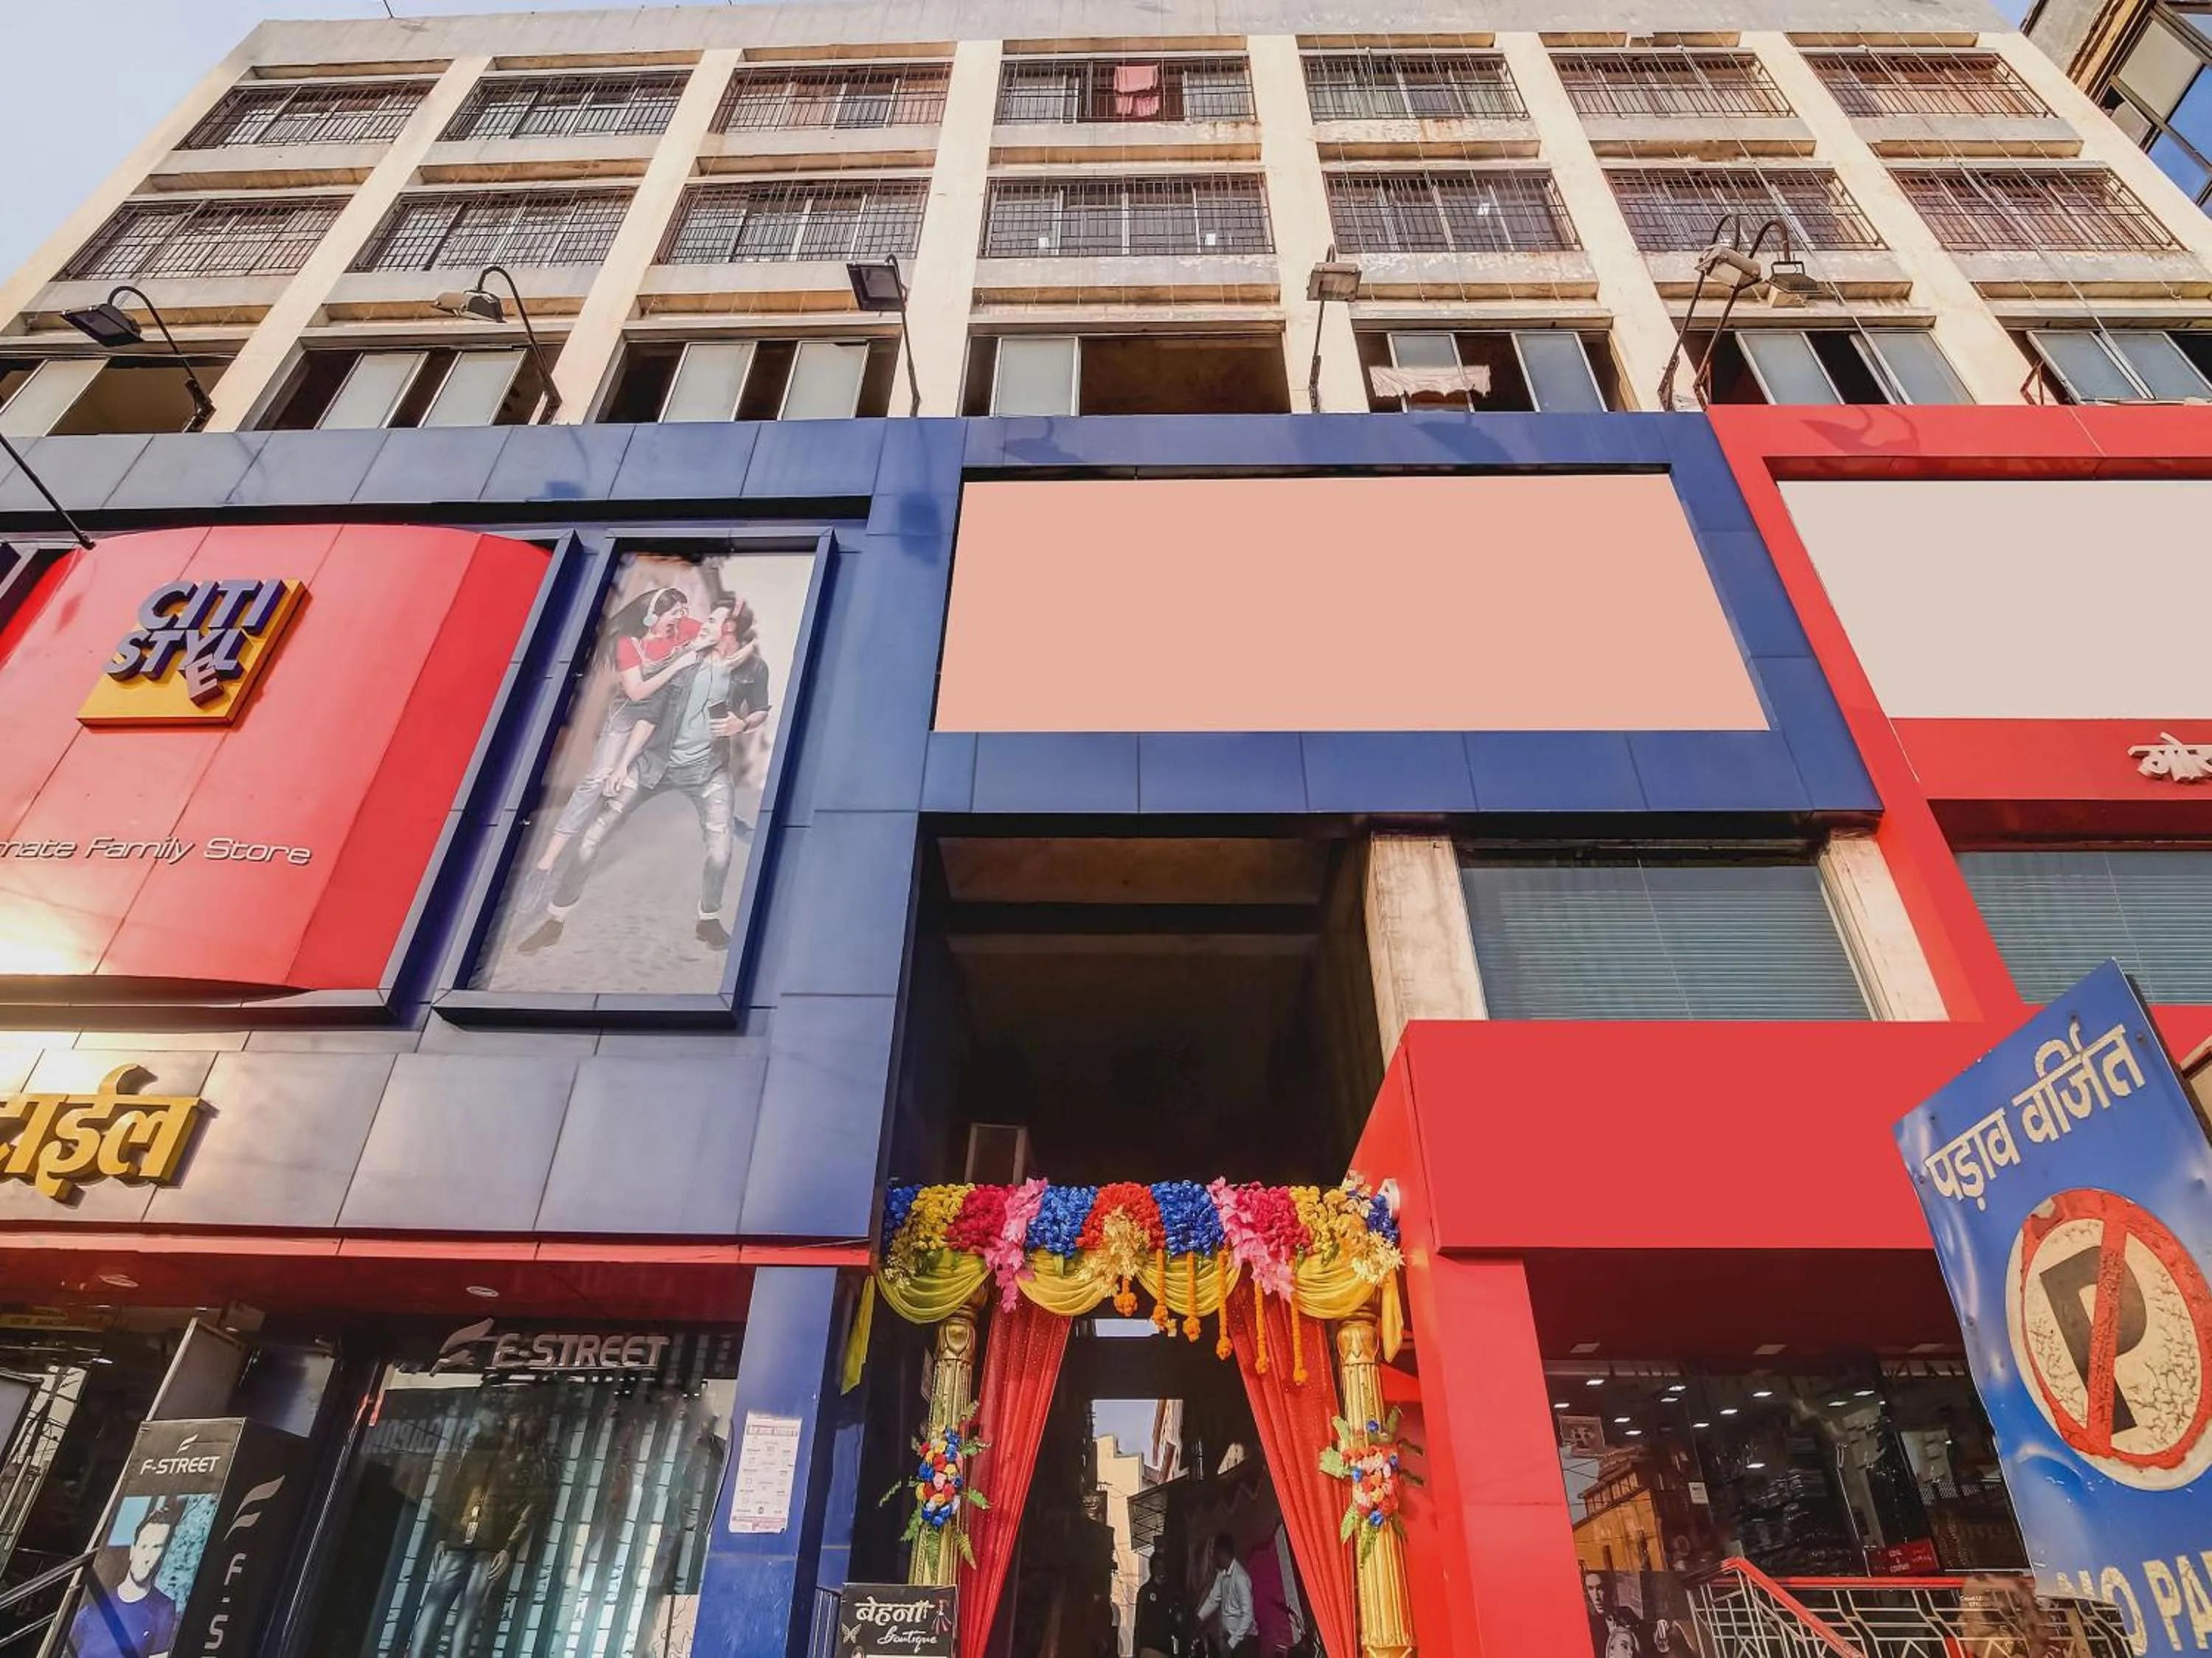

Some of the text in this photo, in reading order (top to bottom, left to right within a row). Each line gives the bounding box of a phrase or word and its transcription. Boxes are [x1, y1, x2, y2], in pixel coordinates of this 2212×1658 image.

[138, 579, 290, 634] CITI
[84, 836, 195, 864] Family
[204, 838, 312, 865] Store
[1924, 1022, 2146, 1211] पड़ाव वर्जित
[140, 1456, 220, 1474] F-STREET
[2144, 1550, 2212, 1651] PA
